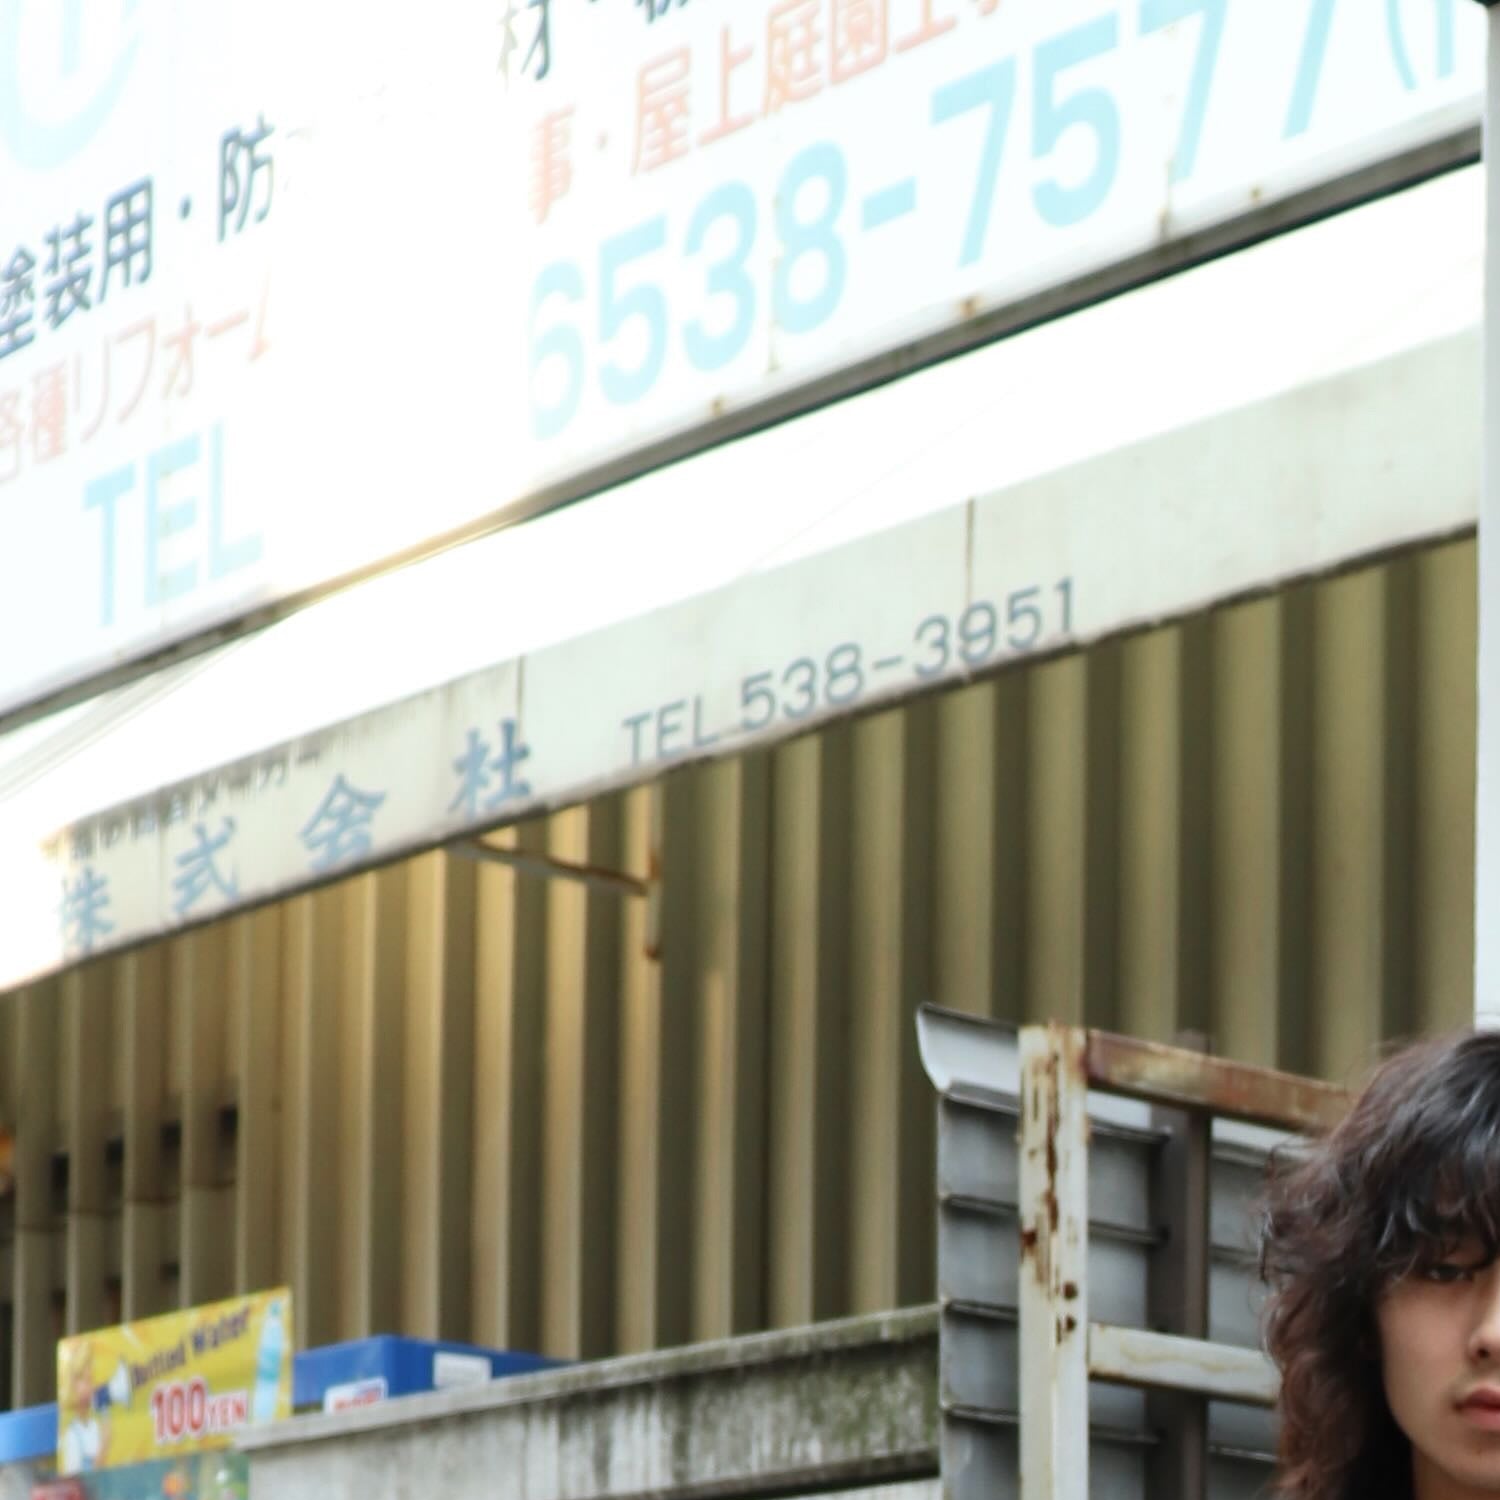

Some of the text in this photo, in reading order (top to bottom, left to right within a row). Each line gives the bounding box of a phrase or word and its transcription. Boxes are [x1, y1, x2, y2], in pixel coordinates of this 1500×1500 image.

[82, 420, 264, 628] TEL
[622, 694, 722, 765] TEL
[153, 1376, 206, 1441] 100
